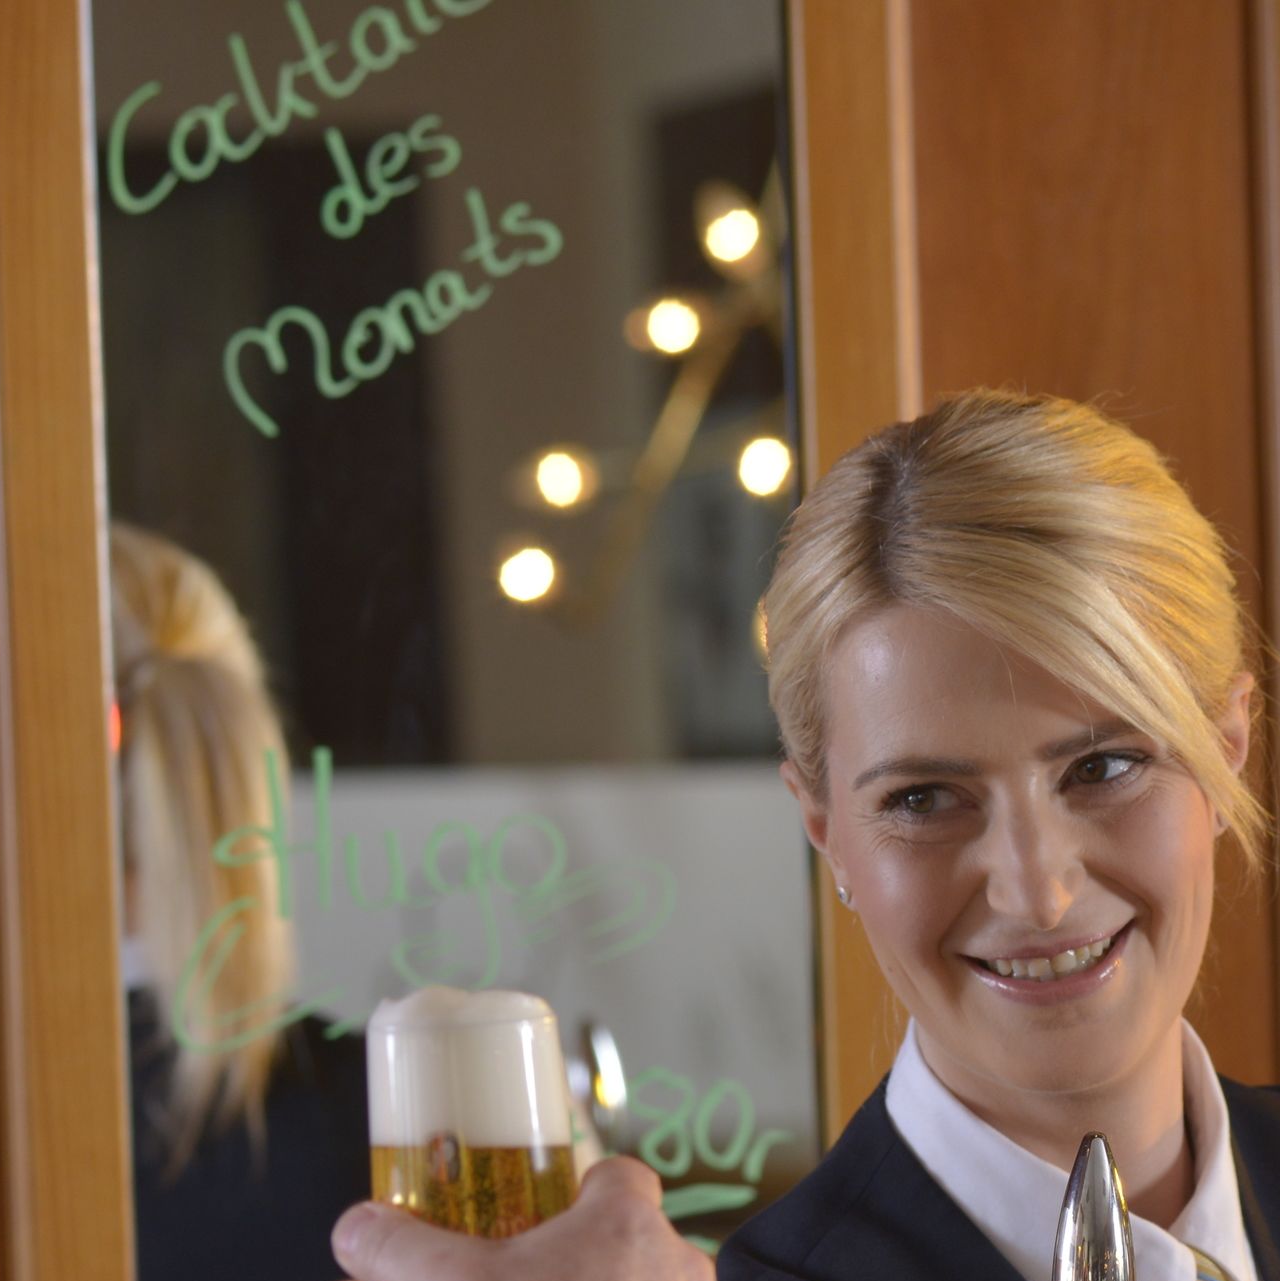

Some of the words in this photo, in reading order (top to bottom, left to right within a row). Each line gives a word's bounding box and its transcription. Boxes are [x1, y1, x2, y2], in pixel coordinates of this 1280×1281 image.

[321, 113, 462, 240] des
[223, 187, 565, 440] Monats
[212, 745, 570, 992] Hugo
